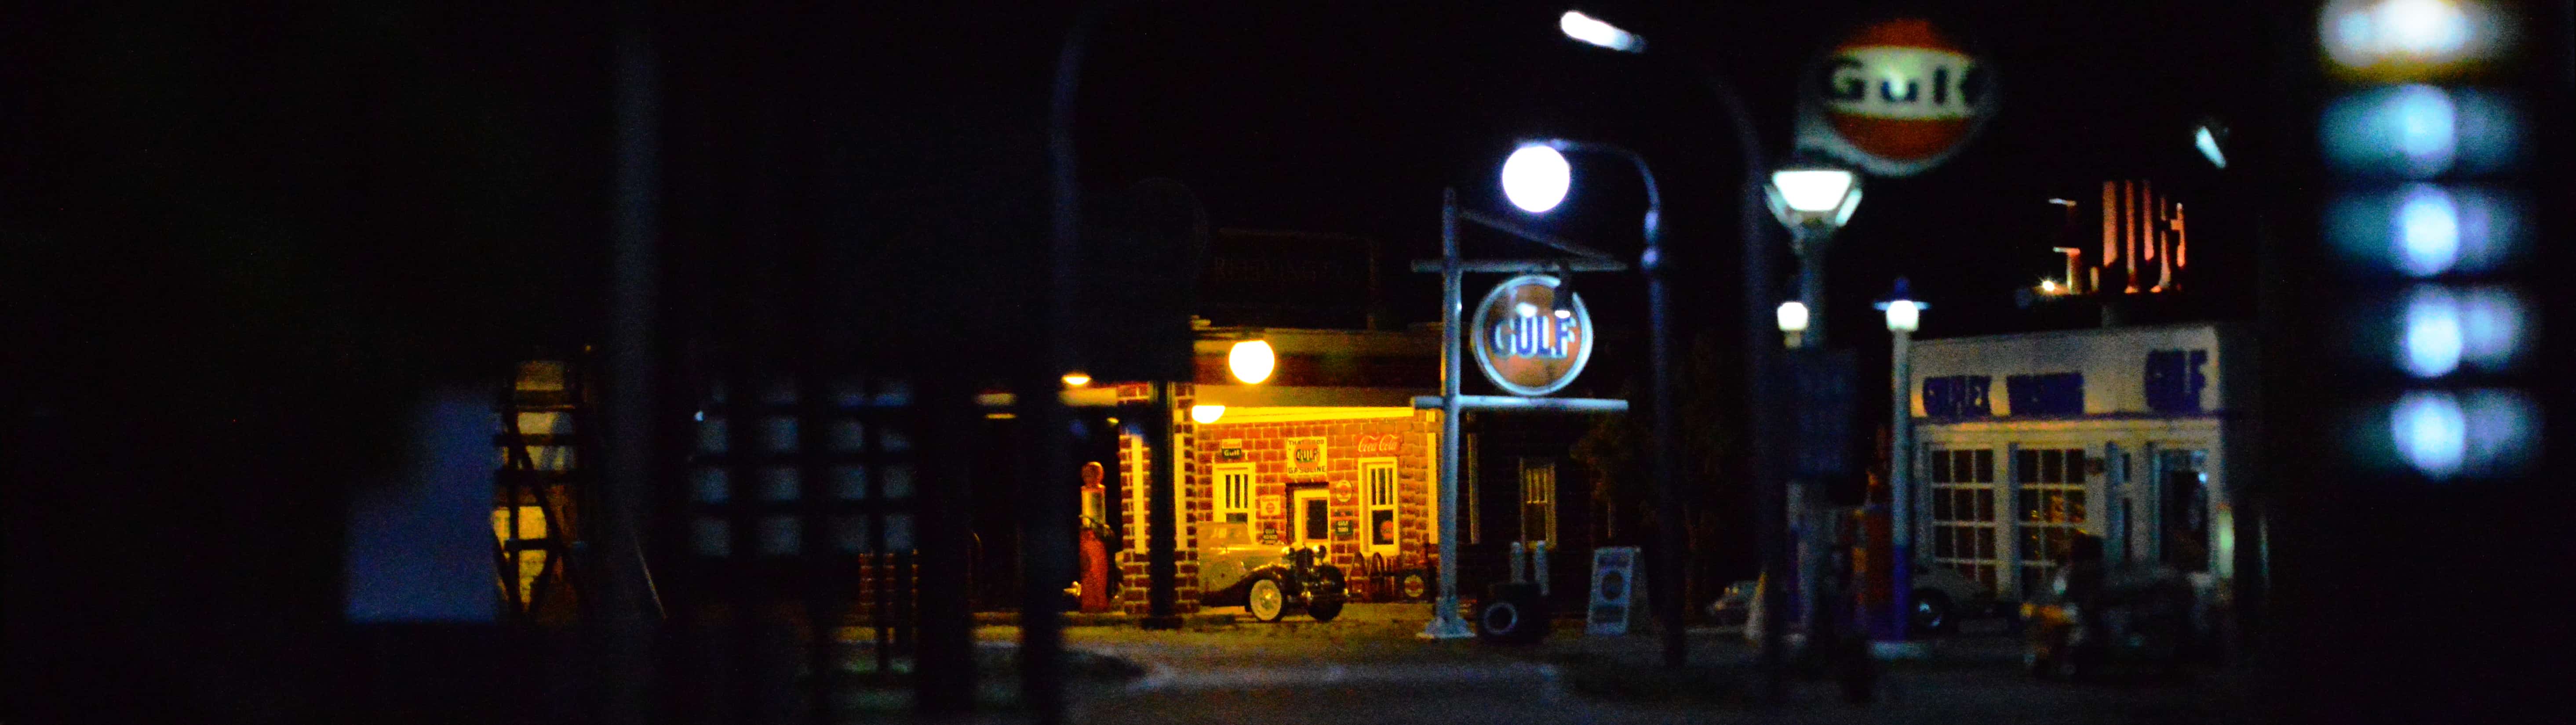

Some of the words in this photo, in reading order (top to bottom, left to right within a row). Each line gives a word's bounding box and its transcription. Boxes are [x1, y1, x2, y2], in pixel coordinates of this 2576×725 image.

[1490, 311, 1578, 358] GULF
[2146, 348, 2207, 412] GULF
[1296, 448, 1319, 463] GULF
